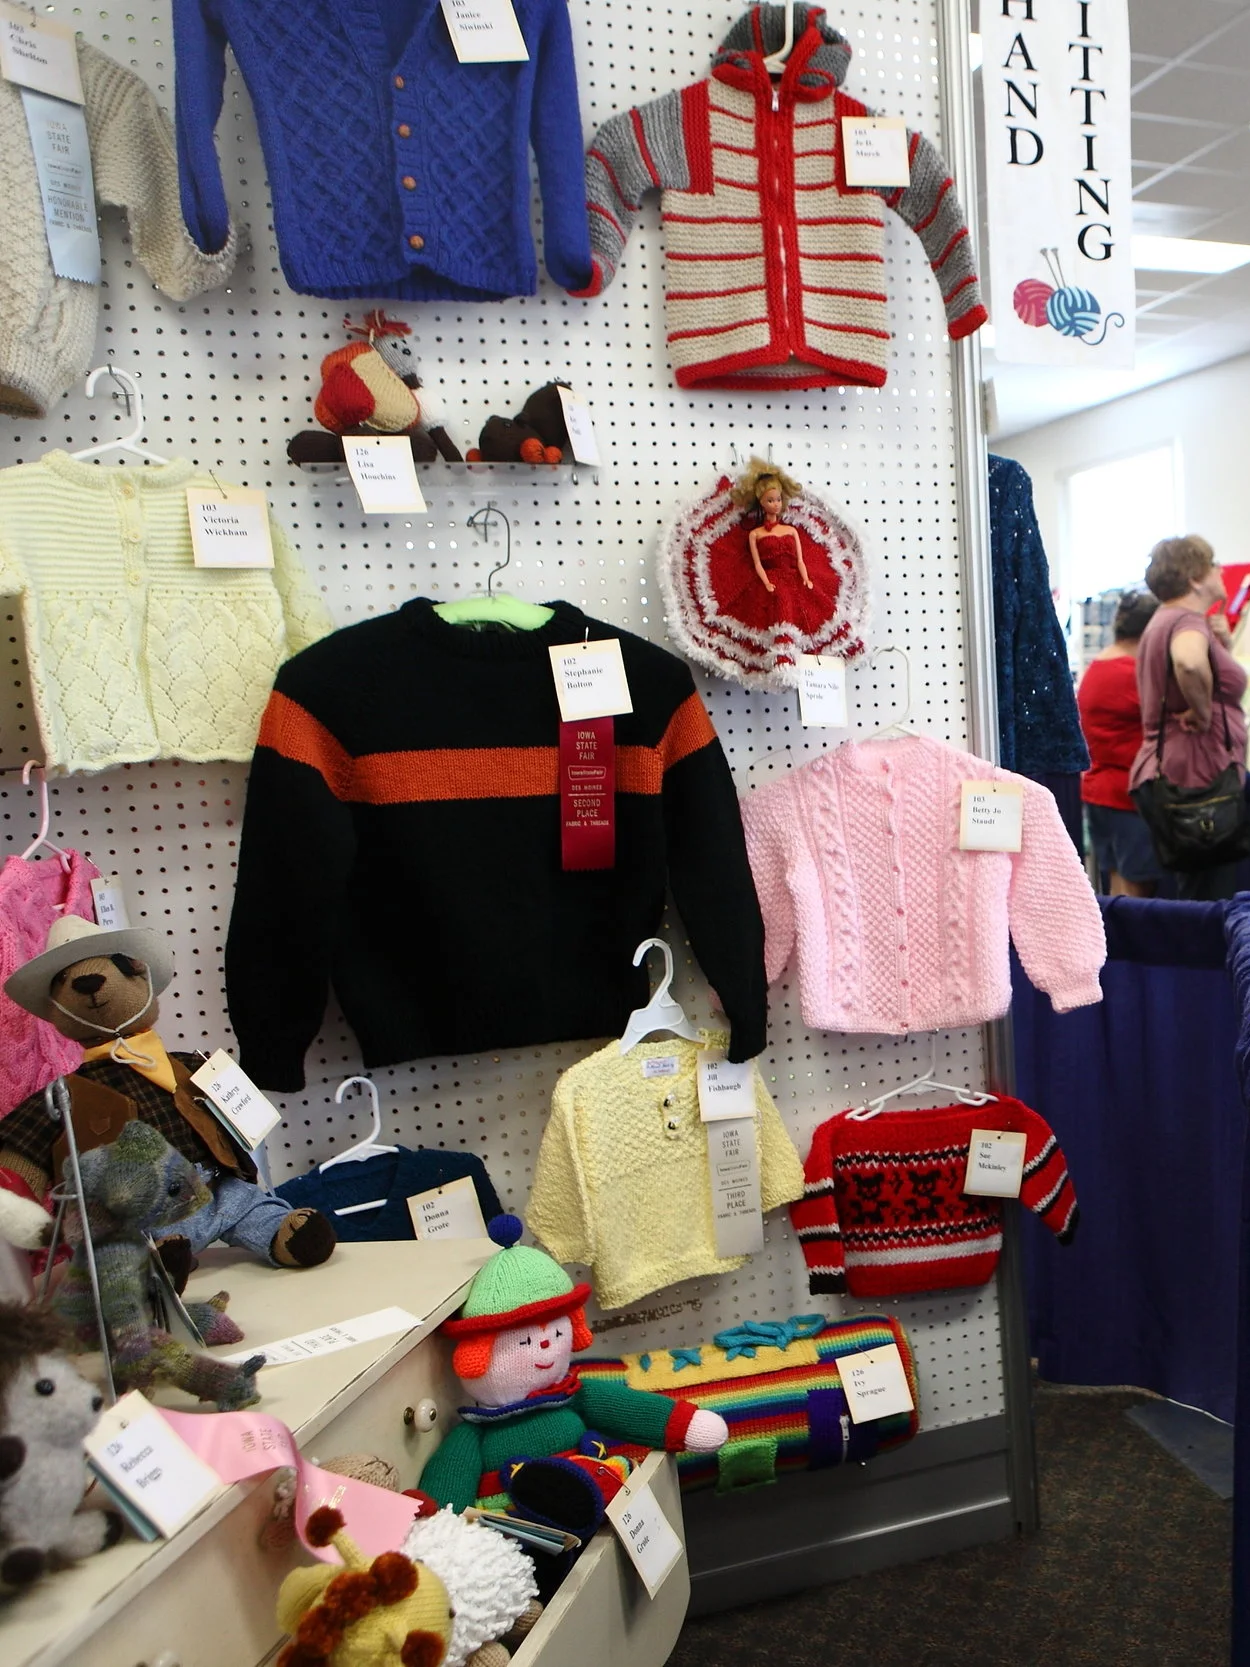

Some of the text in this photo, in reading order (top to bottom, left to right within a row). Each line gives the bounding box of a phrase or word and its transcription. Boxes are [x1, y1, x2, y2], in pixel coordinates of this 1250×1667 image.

[456, 11, 481, 19] Janice
[46, 130, 71, 145] STATE
[52, 143, 70, 156] FAIR
[47, 195, 89, 213] HONORABLE
[53, 208, 86, 223] MENTION
[355, 447, 369, 456] 126
[357, 460, 375, 468] Lisa
[361, 472, 397, 480] Houchins
[203, 516, 240, 524] Victoria
[204, 528, 248, 536] Wickham
[563, 657, 576, 666] 102
[564, 667, 604, 678] Stephanie
[567, 681, 593, 689] Bolton
[577, 731, 596, 740] IOWA
[575, 741, 598, 750] STATE
[579, 751, 595, 760] FAIR
[573, 799, 601, 808] SECOND
[576, 809, 598, 818] PLACE
[972, 806, 991, 814] Betty
[708, 1083, 742, 1093] Fishbaugh
[220, 1085, 240, 1104] Kathryn
[231, 1094, 253, 1115] Crawford
[722, 1129, 739, 1138] IOWA
[722, 1139, 740, 1149] STATE
[725, 1148, 739, 1158] FAIR
[726, 1190, 746, 1200] THIRD
[422, 1201, 435, 1212] 102
[726, 1200, 746, 1209] PLACE
[424, 1209, 450, 1223] Donna
[427, 1221, 450, 1234] Grote
[851, 1369, 865, 1377] 126
[856, 1386, 887, 1398] Sprague
[241, 1430, 257, 1453] IOWA
[120, 1445, 154, 1473] Rebecca
[136, 1466, 163, 1489] Briggs
[622, 1511, 633, 1526] 126
[629, 1519, 645, 1540] Donna
[636, 1535, 651, 1554] Grote
